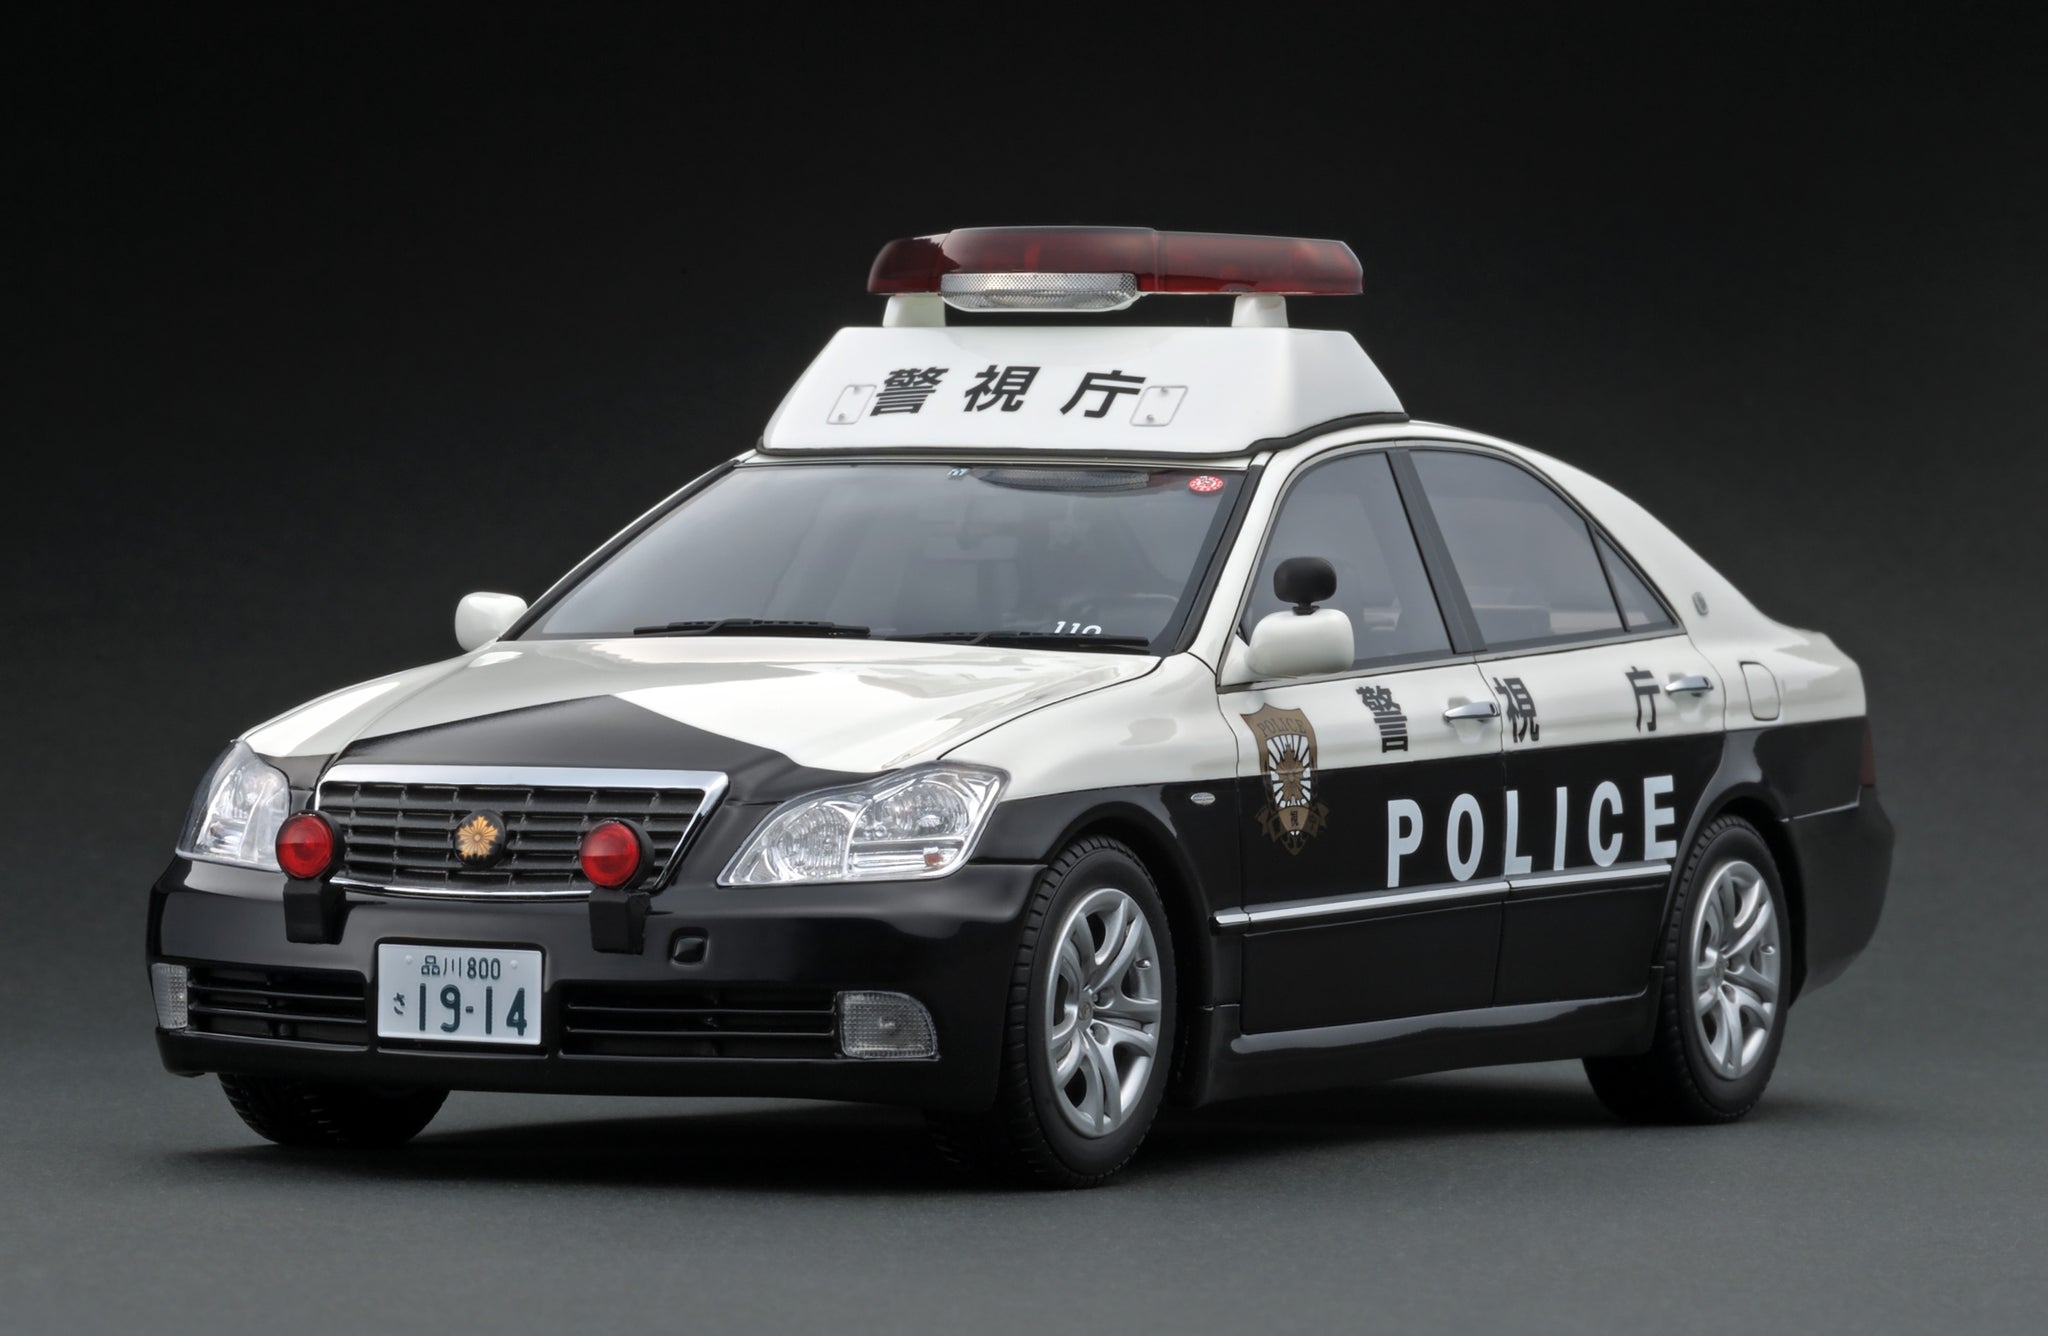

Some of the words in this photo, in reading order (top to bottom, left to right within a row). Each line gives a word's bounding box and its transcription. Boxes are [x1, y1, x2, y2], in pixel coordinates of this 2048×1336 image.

[869, 364, 1147, 418] 警視庁
[1257, 717, 1307, 737] POLICE
[1387, 774, 1677, 888] POLICE
[393, 992, 406, 1015] さ
[419, 983, 528, 1037] 19-14
